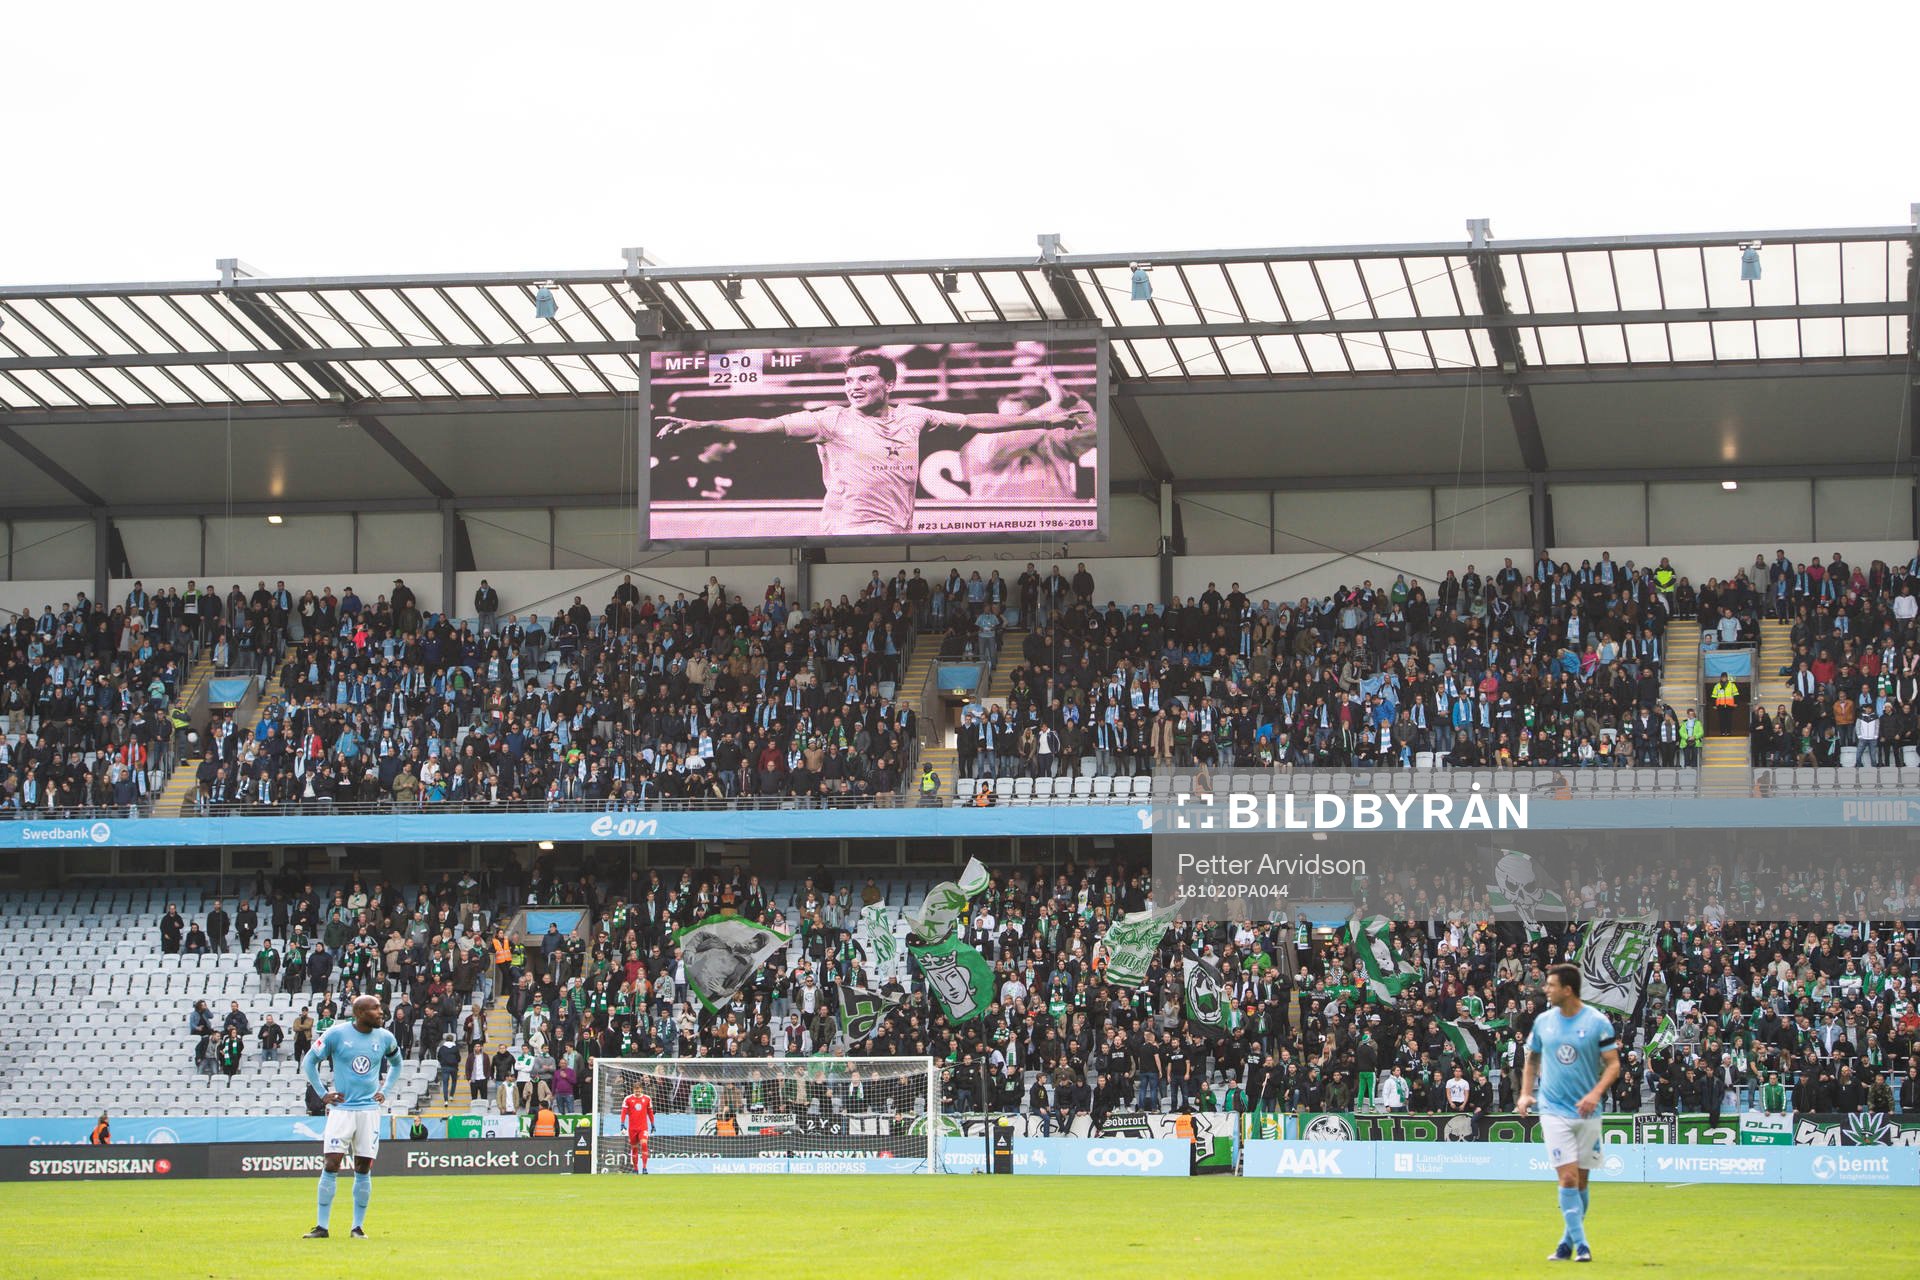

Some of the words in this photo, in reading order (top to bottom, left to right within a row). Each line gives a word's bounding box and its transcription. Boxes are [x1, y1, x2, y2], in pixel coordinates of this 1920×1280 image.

[665, 357, 706, 370] MFF
[719, 356, 751, 368] 0-0
[771, 354, 803, 367] HIF
[713, 372, 758, 384] 22:08
[917, 522, 938, 531] #23
[940, 521, 987, 531] LABINOT
[989, 520, 1037, 530] HARBUZI
[1040, 519, 1094, 528] 1986-2018
[1843, 800, 1908, 822] PUMA
[22, 827, 89, 840] Swedbank
[1103, 1115, 1147, 1127] Söderort
[1751, 1135, 1774, 1144] 121
[29, 1159, 154, 1175] SYDSVENSKAN
[407, 1151, 519, 1168] Försnacket
[524, 1151, 559, 1167] och
[1087, 1147, 1164, 1172] coop
[1276, 1149, 1343, 1175] AAK
[1674, 1157, 1766, 1171] INTERSPORT
[1839, 1155, 1888, 1172] bemt
[712, 1163, 746, 1174] HALVA
[750, 1162, 785, 1173] PRISET
[790, 1162, 814, 1173] MED
[816, 1162, 866, 1173] BROPASS
